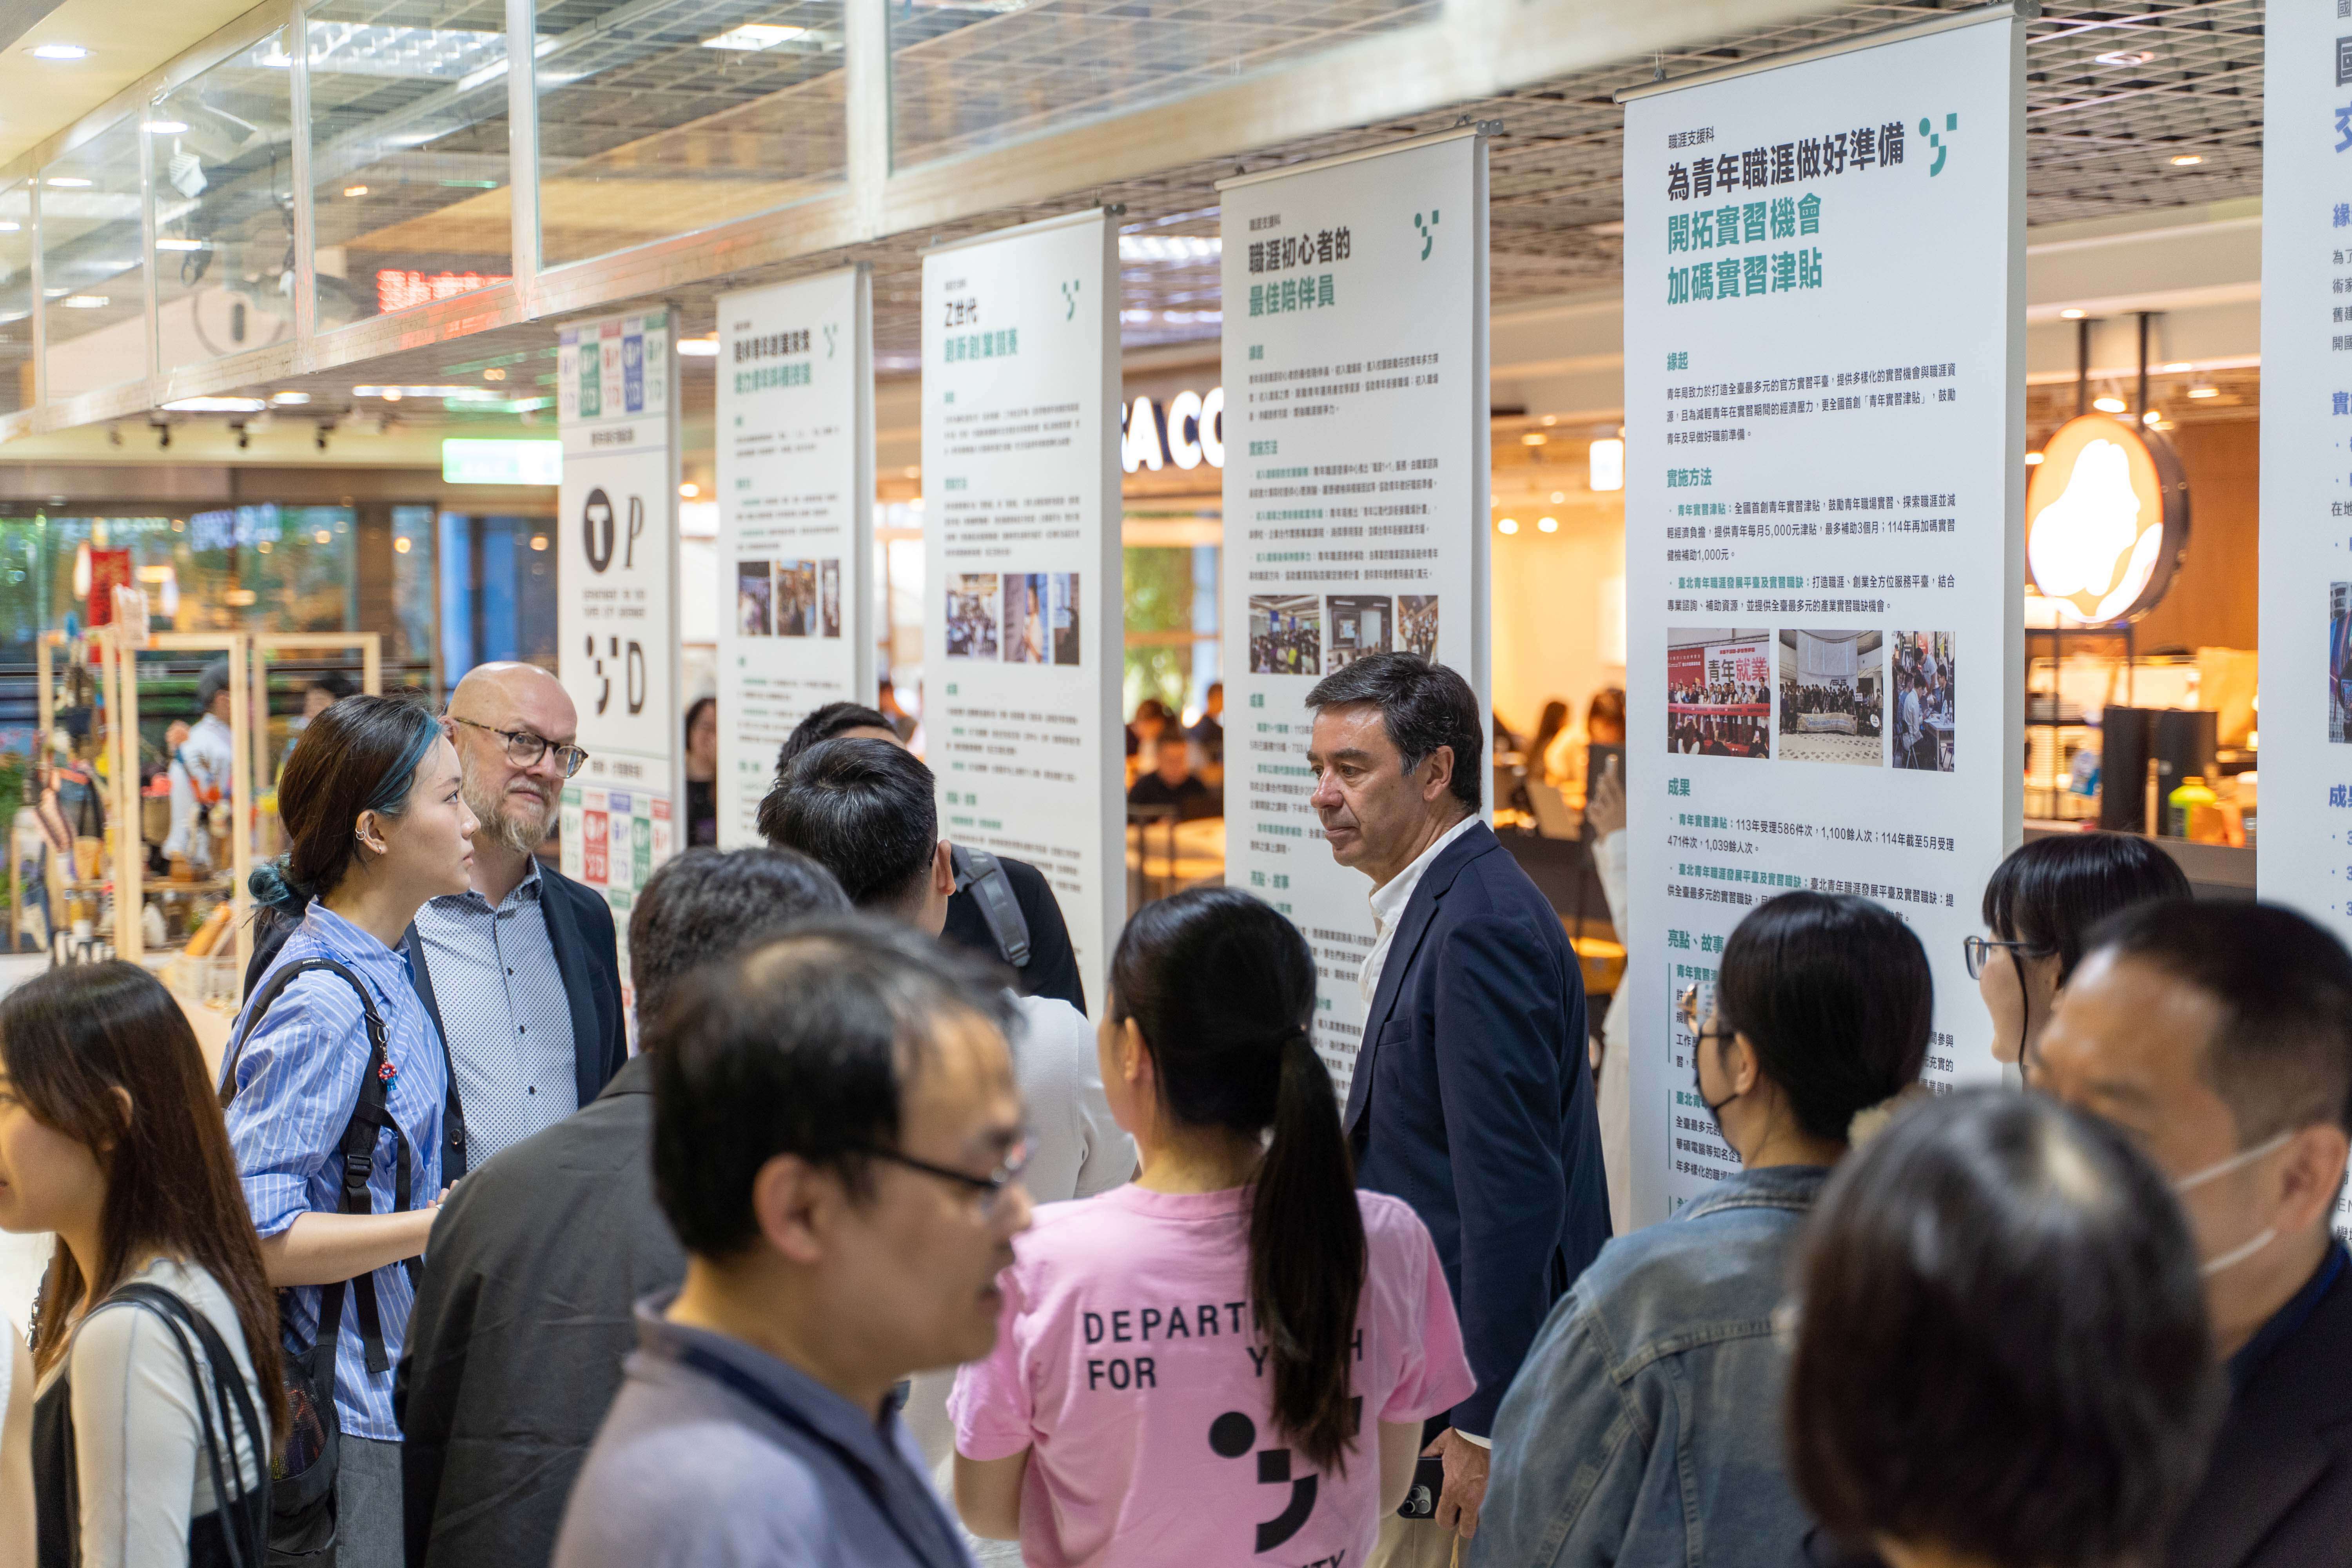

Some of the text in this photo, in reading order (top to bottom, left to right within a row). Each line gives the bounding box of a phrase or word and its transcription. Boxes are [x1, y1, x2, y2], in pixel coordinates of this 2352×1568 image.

[1668, 126, 1715, 150] 職涯支援科
[1668, 122, 1905, 201] 為青年職涯做好準備
[1668, 192, 1822, 254] 開拓實習機會
[2333, 203, 2352, 228] 緣
[1249, 226, 1351, 275] 職涯初心者的
[1668, 247, 1822, 306] 加碼實習津貼
[1249, 274, 1335, 317] 最佳陪伴員
[945, 297, 977, 327] Z世代
[1667, 352, 1688, 372] 緣起
[1667, 363, 1956, 401] 青年局致力於打造全臺最多元的官方實習平臺，提供多樣化的實習機會與職涯資
[1667, 388, 1956, 423] 源，且為減輕青年在實習期間的經濟壓力，更全國首創「青年實習津貼」，鼓勵
[2332, 391, 2352, 416] 實
[1667, 428, 1751, 446] 青年及早做好職前準備。
[1667, 467, 1712, 488] 實施方法
[1667, 549, 1735, 563] 健檢補助1,000元。
[1667, 599, 1891, 613] 專業諮詢、補助資源，並提供全臺最多元的產業實習職缺機會。
[1668, 777, 1691, 797] 成果
[1668, 834, 1759, 855] 471件次，1,039餘人次。
[1668, 884, 1775, 907] 供全臺最多元的實習職缺，目
[1668, 929, 1724, 954] 亮點、故事
[1083, 1301, 1246, 1345] DEPART
[1088, 1357, 1157, 1390] FOR
